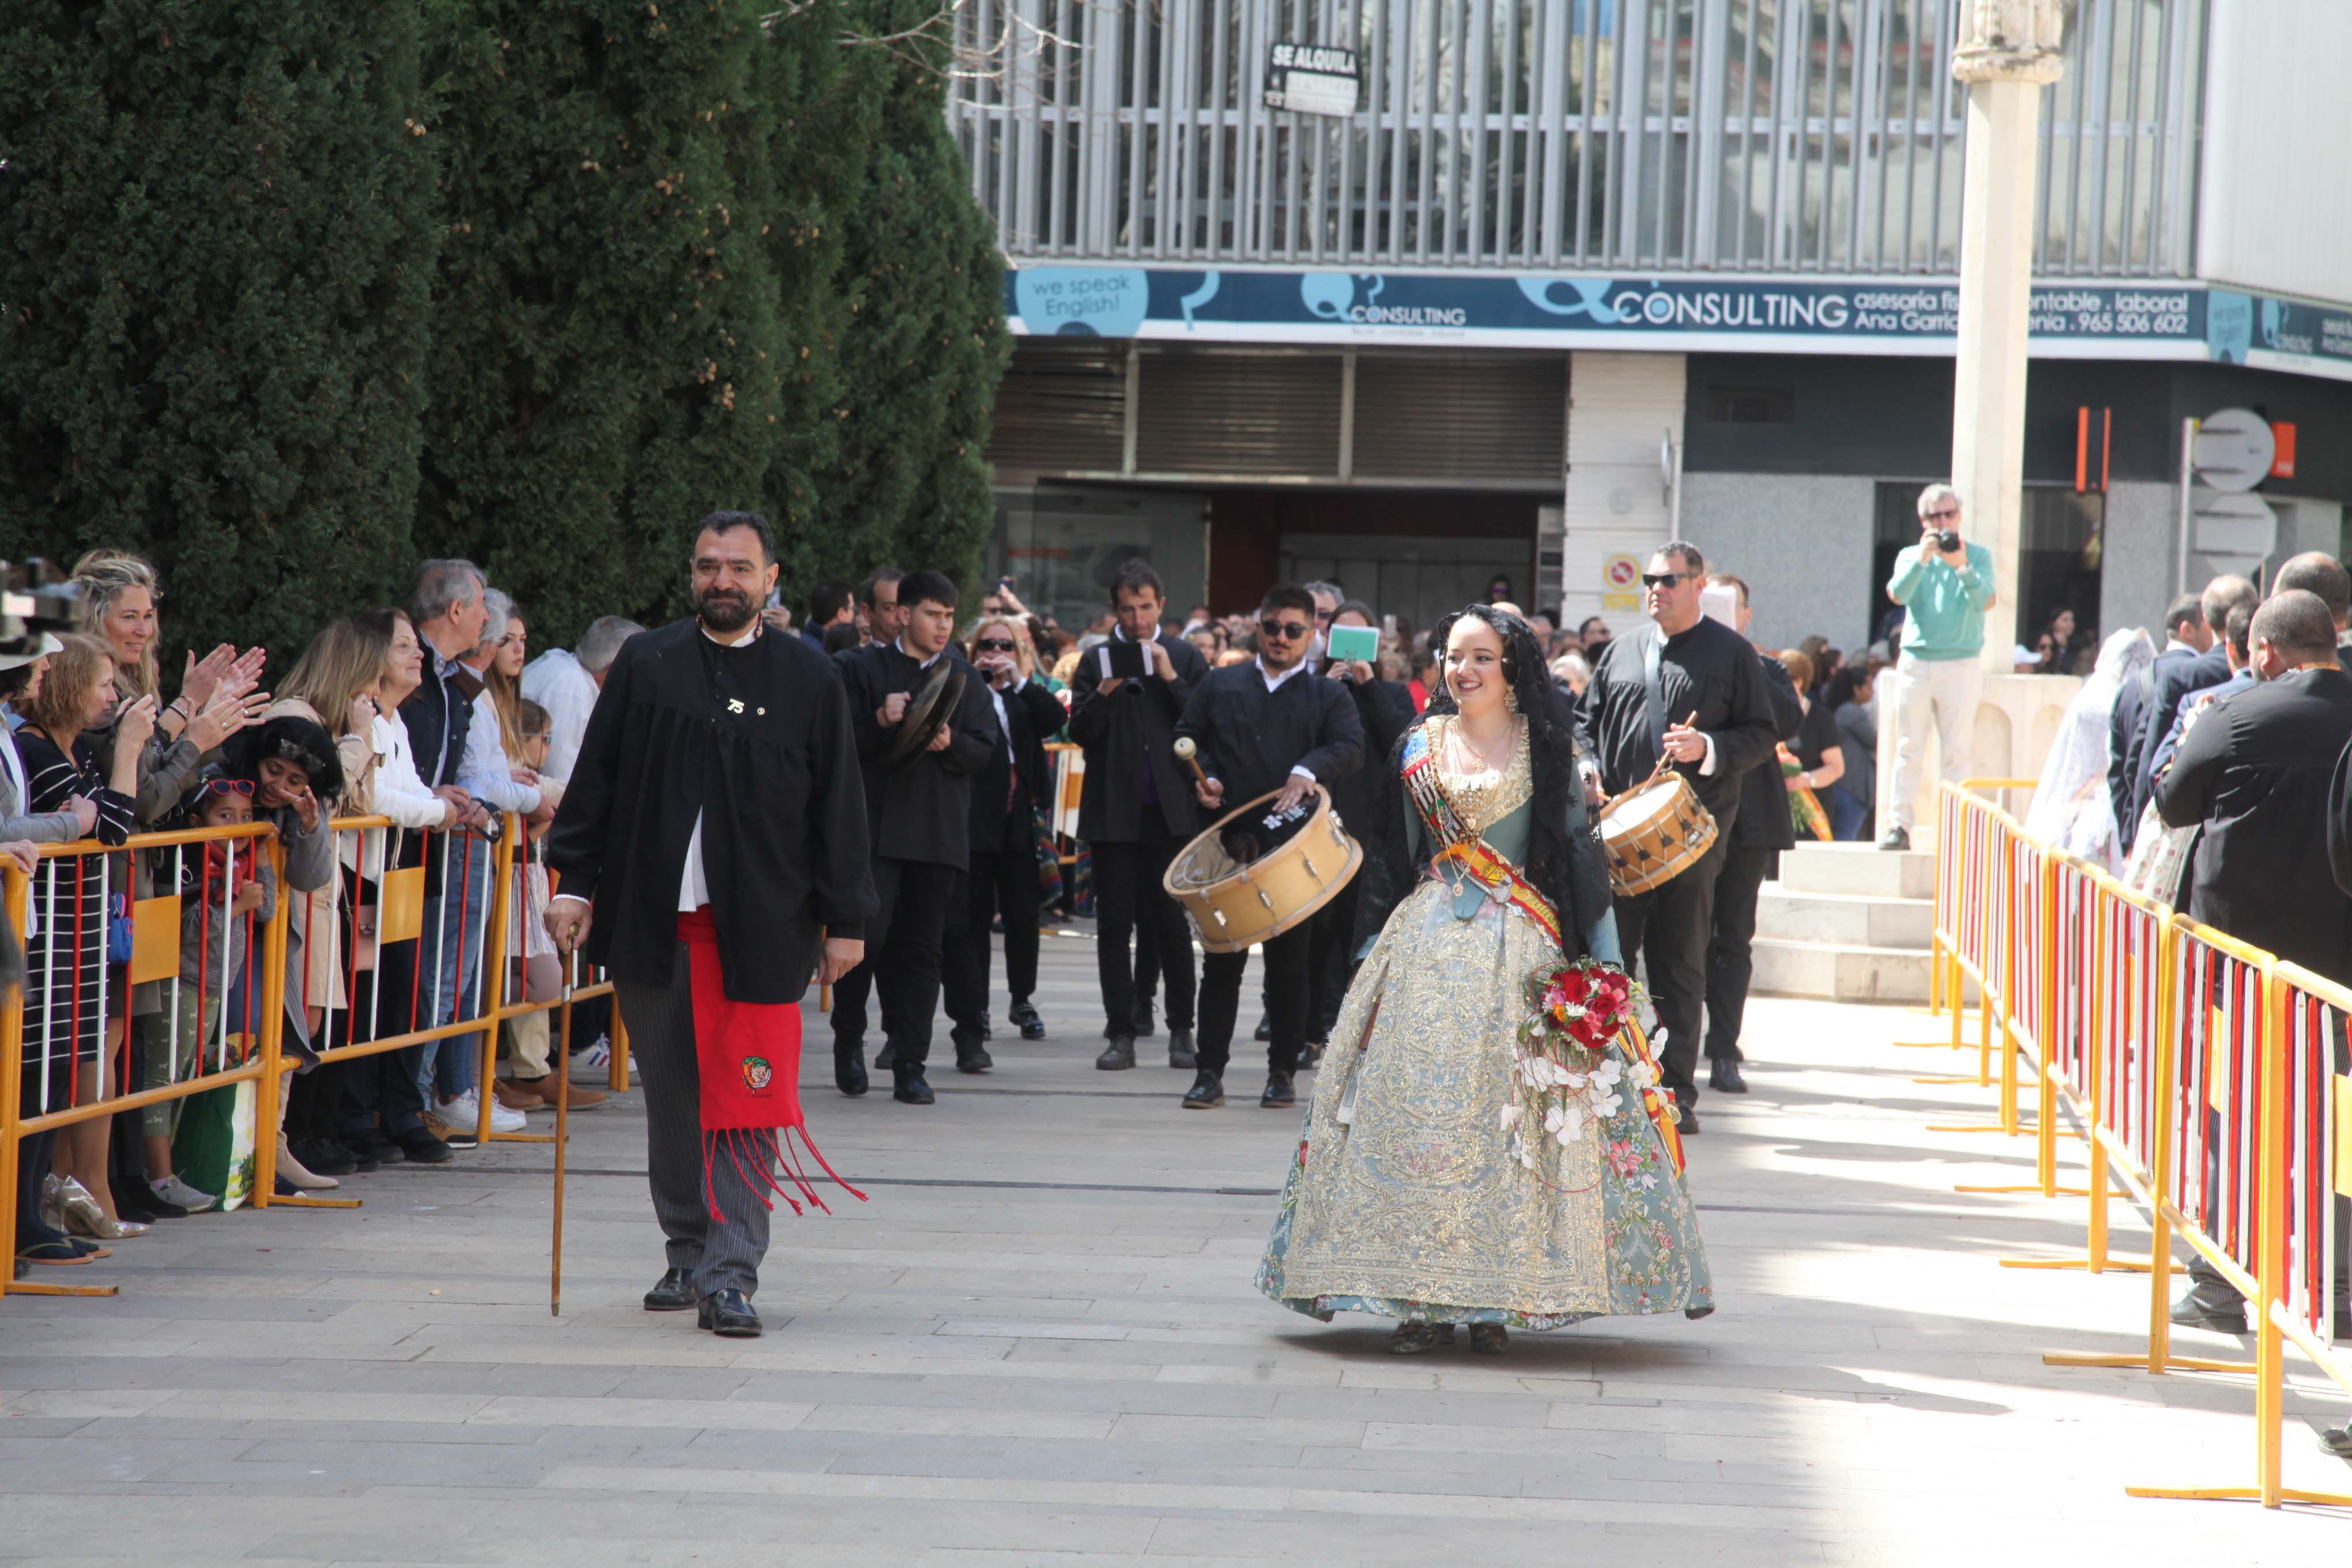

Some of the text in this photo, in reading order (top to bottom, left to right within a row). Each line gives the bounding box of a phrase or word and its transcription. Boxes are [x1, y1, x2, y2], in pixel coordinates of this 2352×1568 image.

[1273, 44, 1357, 75] SE ALQUILA
[1033, 274, 1130, 296] we speak
[1045, 295, 1120, 318] English!
[1614, 291, 1849, 328] CONSULTING
[1853, 289, 1938, 311] asesoría
[1942, 290, 1959, 311] fis
[2115, 292, 2189, 313] laboral
[1351, 305, 1467, 326] CONSULTING
[1853, 311, 1898, 330] Ana
[2078, 312, 2113, 333] 965
[2115, 312, 2151, 333] 506
[2152, 313, 2188, 333] 602
[727, 698, 745, 714] 75
